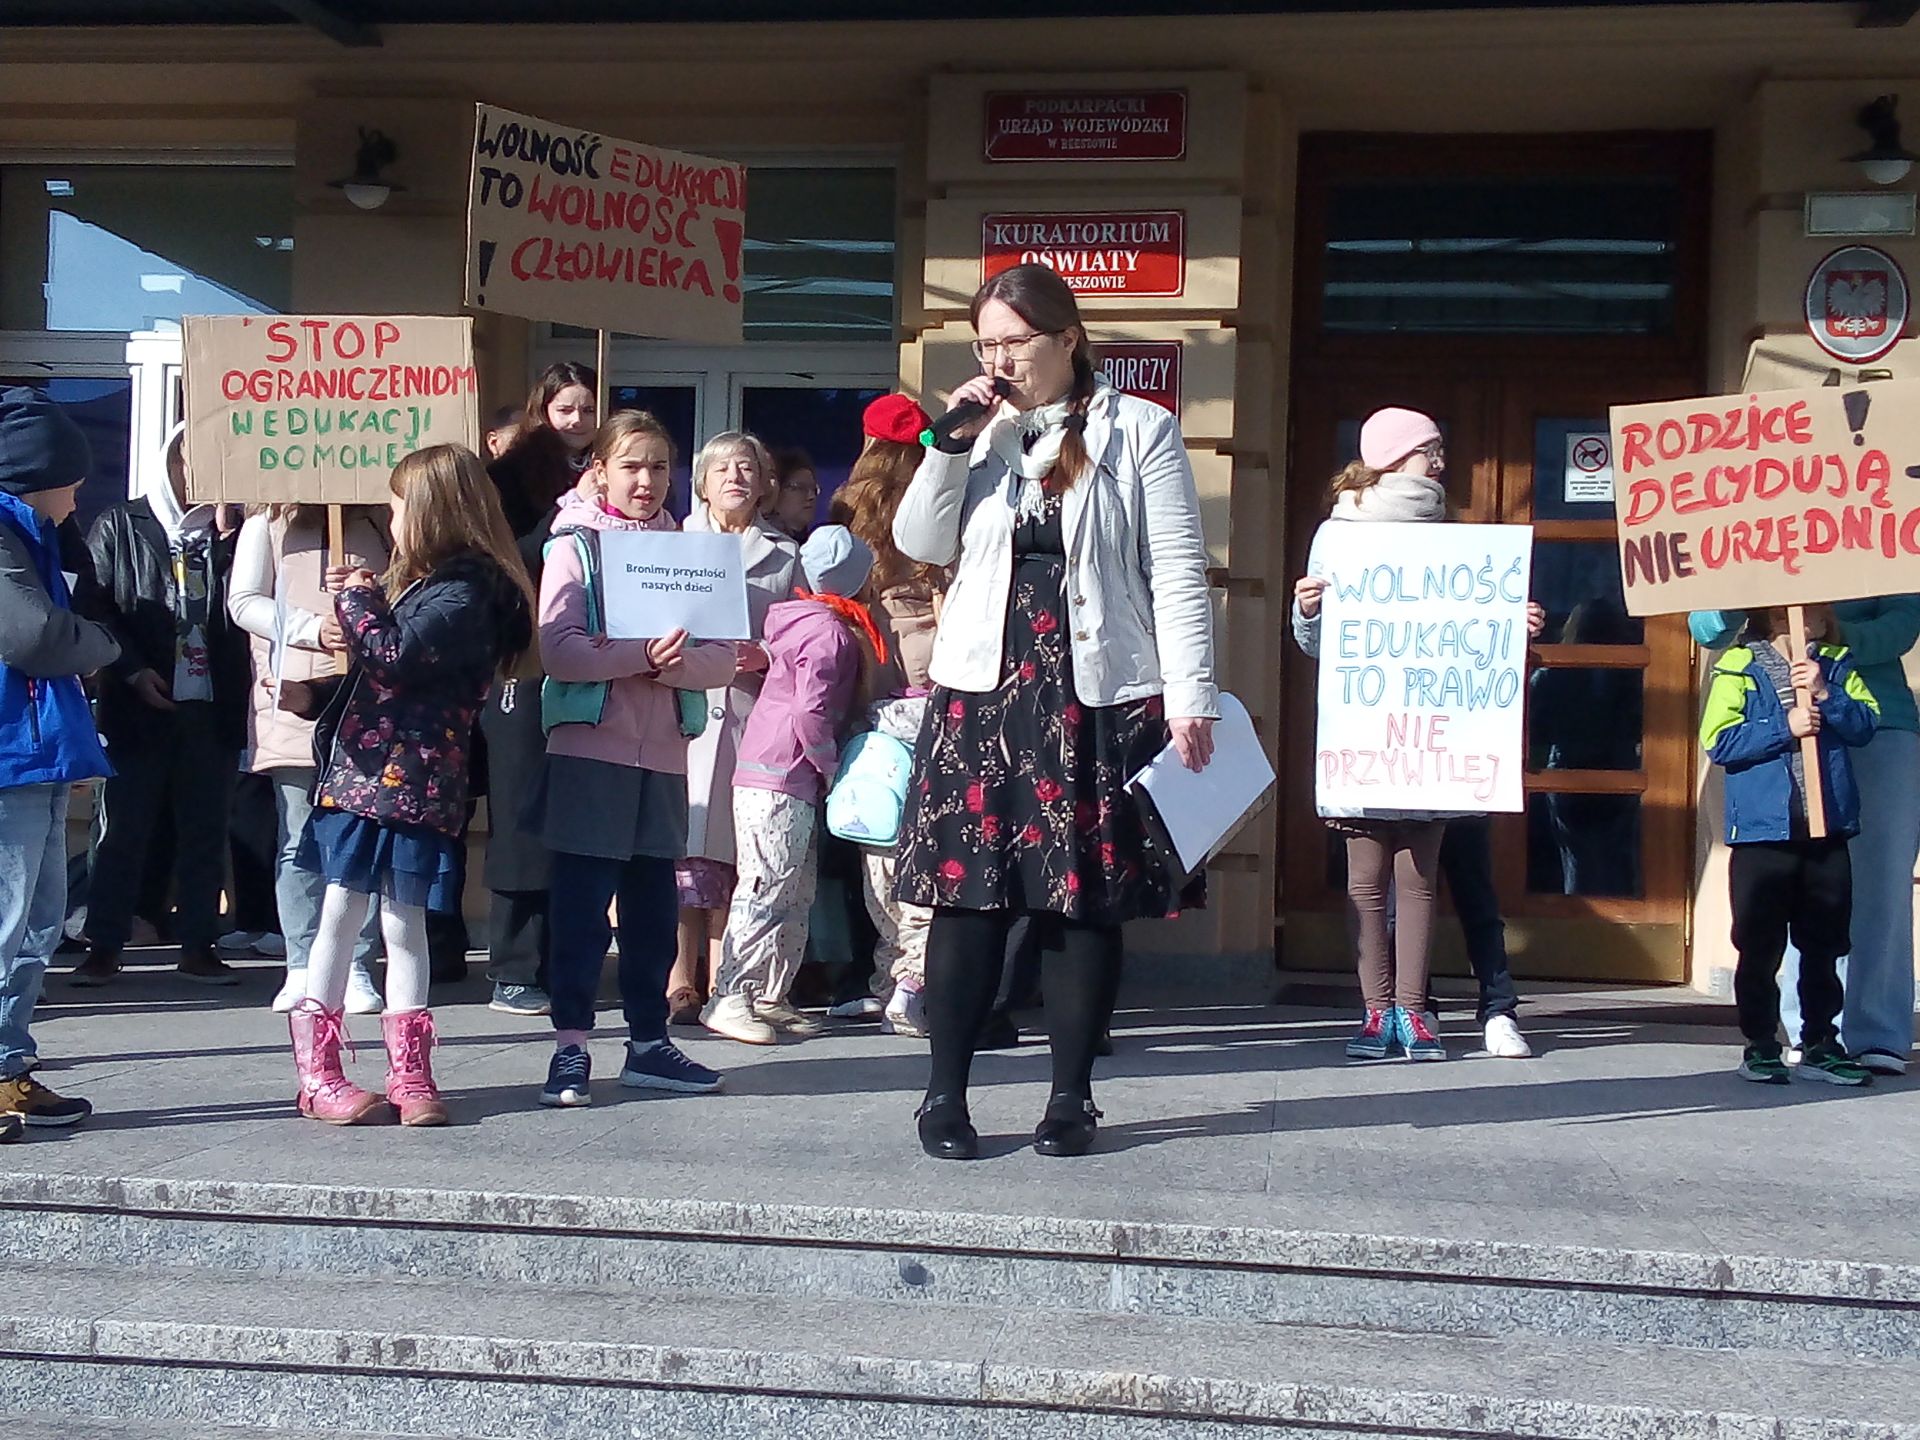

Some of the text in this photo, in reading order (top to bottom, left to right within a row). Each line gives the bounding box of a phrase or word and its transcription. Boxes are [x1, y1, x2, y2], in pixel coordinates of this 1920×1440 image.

[1000, 116, 1169, 136] URZĄD WOJEWÓDZKI
[1048, 138, 1056, 149] W
[478, 113, 748, 211] WOLNOŚĆ EDUKACJI
[480, 167, 524, 208] TO
[993, 222, 1170, 245] KURATORIUM
[1020, 246, 1140, 272] OŚWIATY
[1062, 276, 1126, 289] ESZOWIE
[266, 321, 400, 363] STOP
[221, 364, 475, 402] OGRANICZENIOM
[1102, 357, 1170, 390] BORCZY
[263, 406, 431, 441] EDUKACJI
[1620, 394, 1813, 473] RODZICE
[259, 440, 416, 470] DOMOWE
[1623, 449, 1893, 526] DECYDUJĄ
[626, 563, 726, 579] Bronimy przyszłości
[1624, 531, 1696, 587] NIE
[641, 581, 713, 593] naszych dzieci
[1332, 555, 1523, 604] WOLNOŚĆ
[1339, 618, 1513, 670] EDUKACJI
[1336, 665, 1519, 712] TO PRAWO
[1387, 712, 1450, 752] NIE
